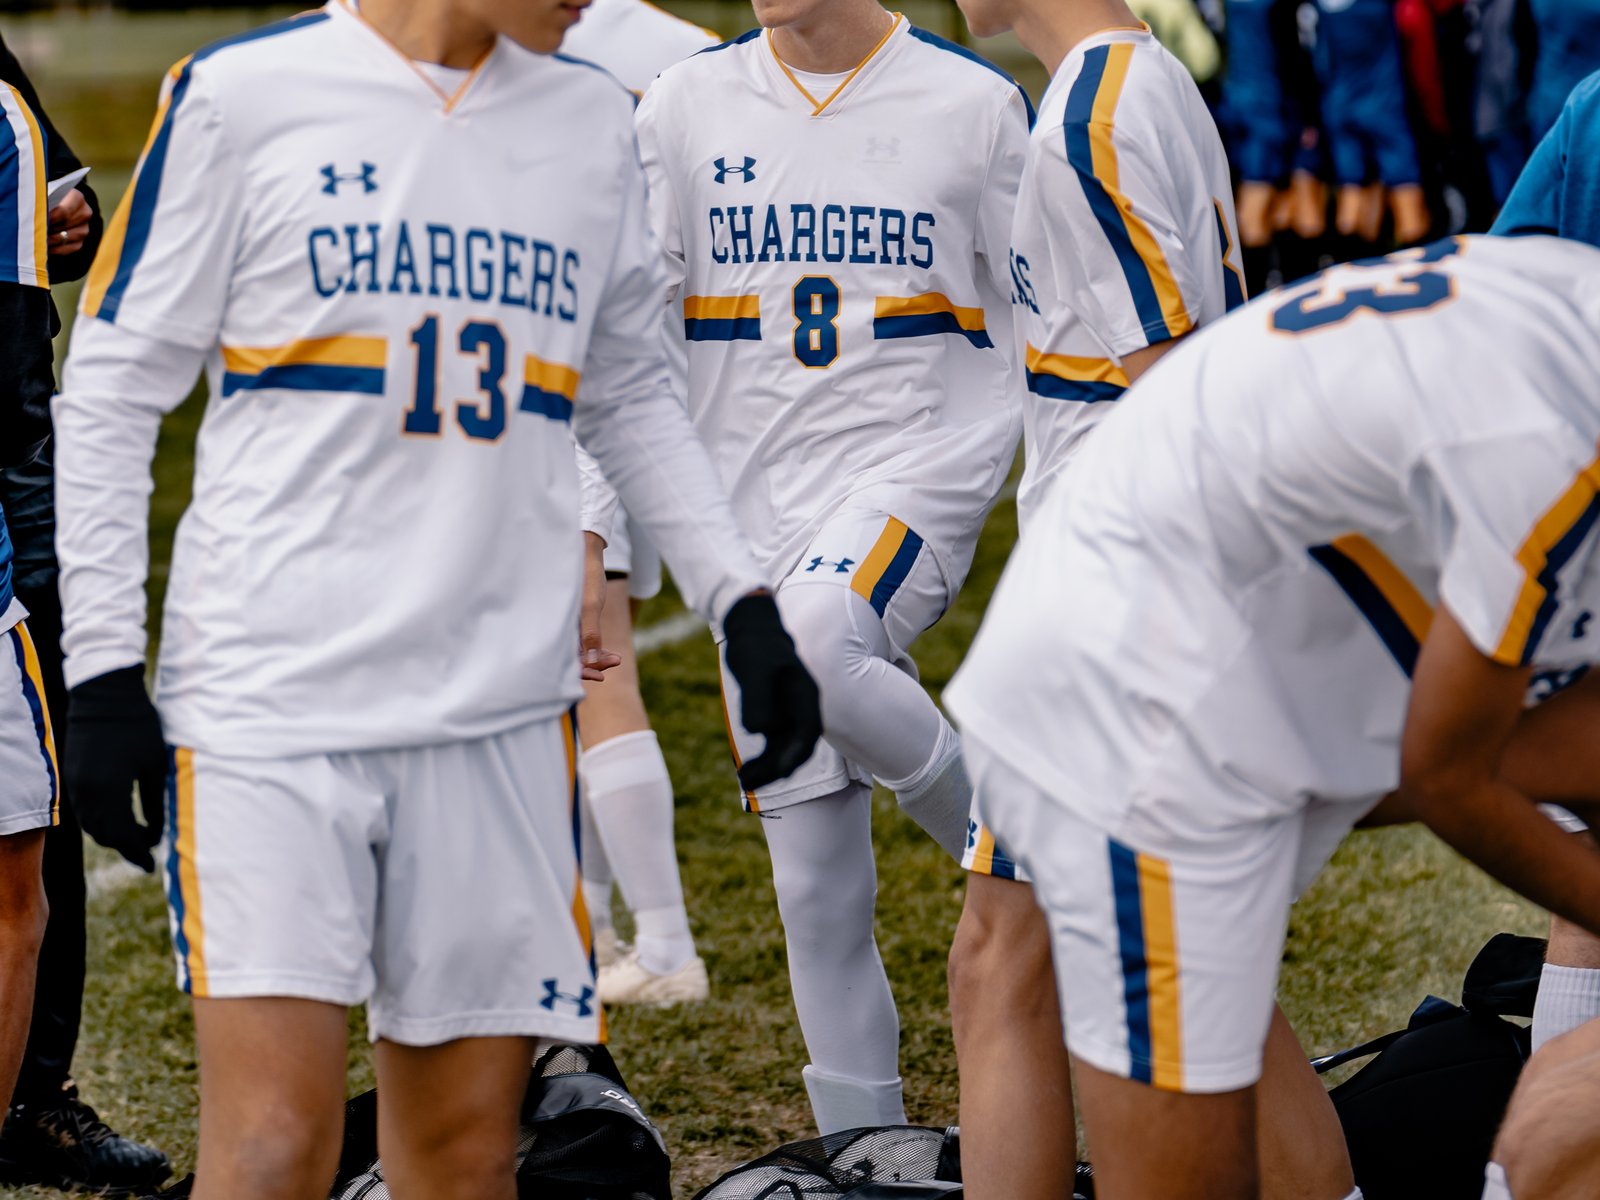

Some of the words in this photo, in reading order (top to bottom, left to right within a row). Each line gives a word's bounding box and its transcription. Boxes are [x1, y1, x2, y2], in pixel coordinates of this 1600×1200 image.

[307, 219, 581, 323] CHARGERS
[709, 203, 936, 270] CHARGERS
[791, 273, 842, 370] 8
[400, 311, 509, 445] 13
